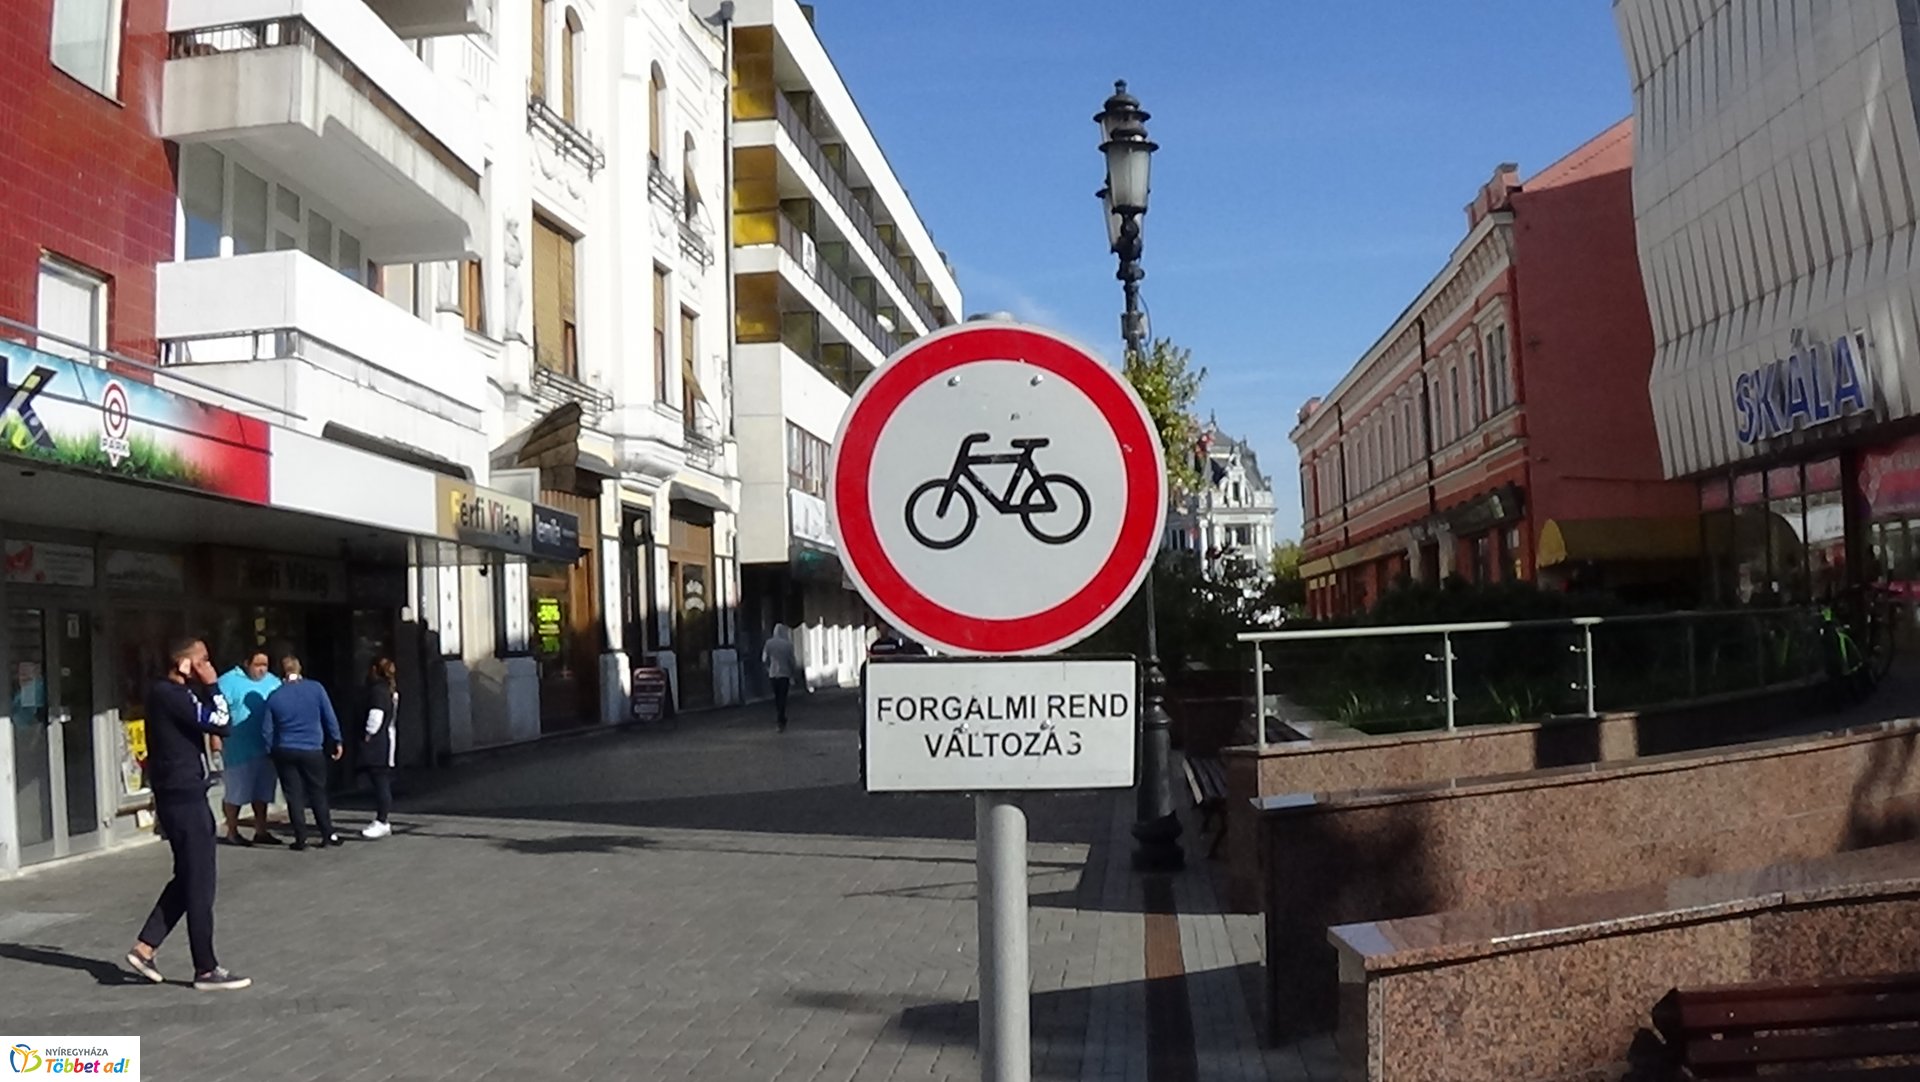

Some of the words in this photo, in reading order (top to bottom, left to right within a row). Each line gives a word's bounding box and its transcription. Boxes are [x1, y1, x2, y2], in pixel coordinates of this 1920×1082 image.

[102, 438, 129, 455] PARK
[450, 490, 484, 530] Férfi
[488, 499, 520, 544] Világ
[877, 695, 1036, 721] FORGALMI
[1047, 694, 1128, 718] REND
